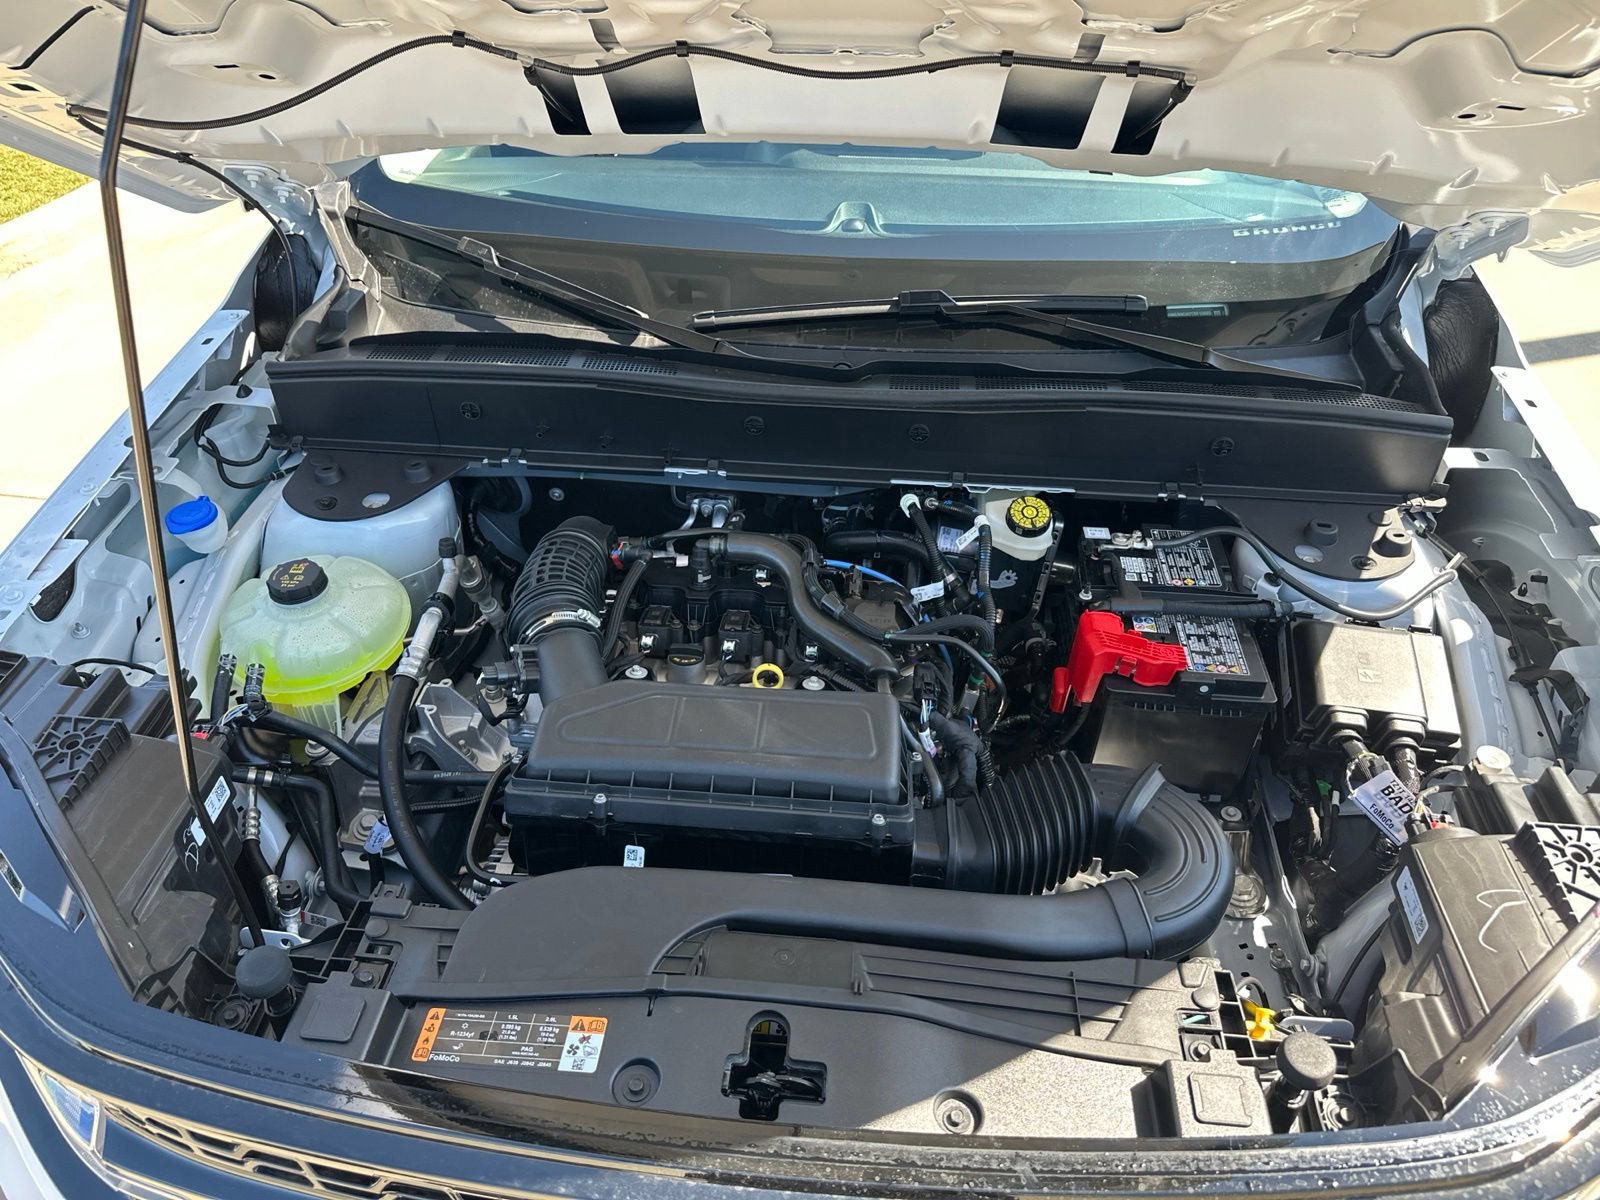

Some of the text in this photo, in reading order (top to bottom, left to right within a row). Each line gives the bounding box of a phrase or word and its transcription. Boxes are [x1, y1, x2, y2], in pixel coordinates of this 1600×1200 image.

[1380, 785, 1414, 815] BAD
[1369, 803, 1394, 830] FoMoCo
[450, 1030, 475, 1038] R-1234yf
[428, 1053, 460, 1063] FoMoCo
